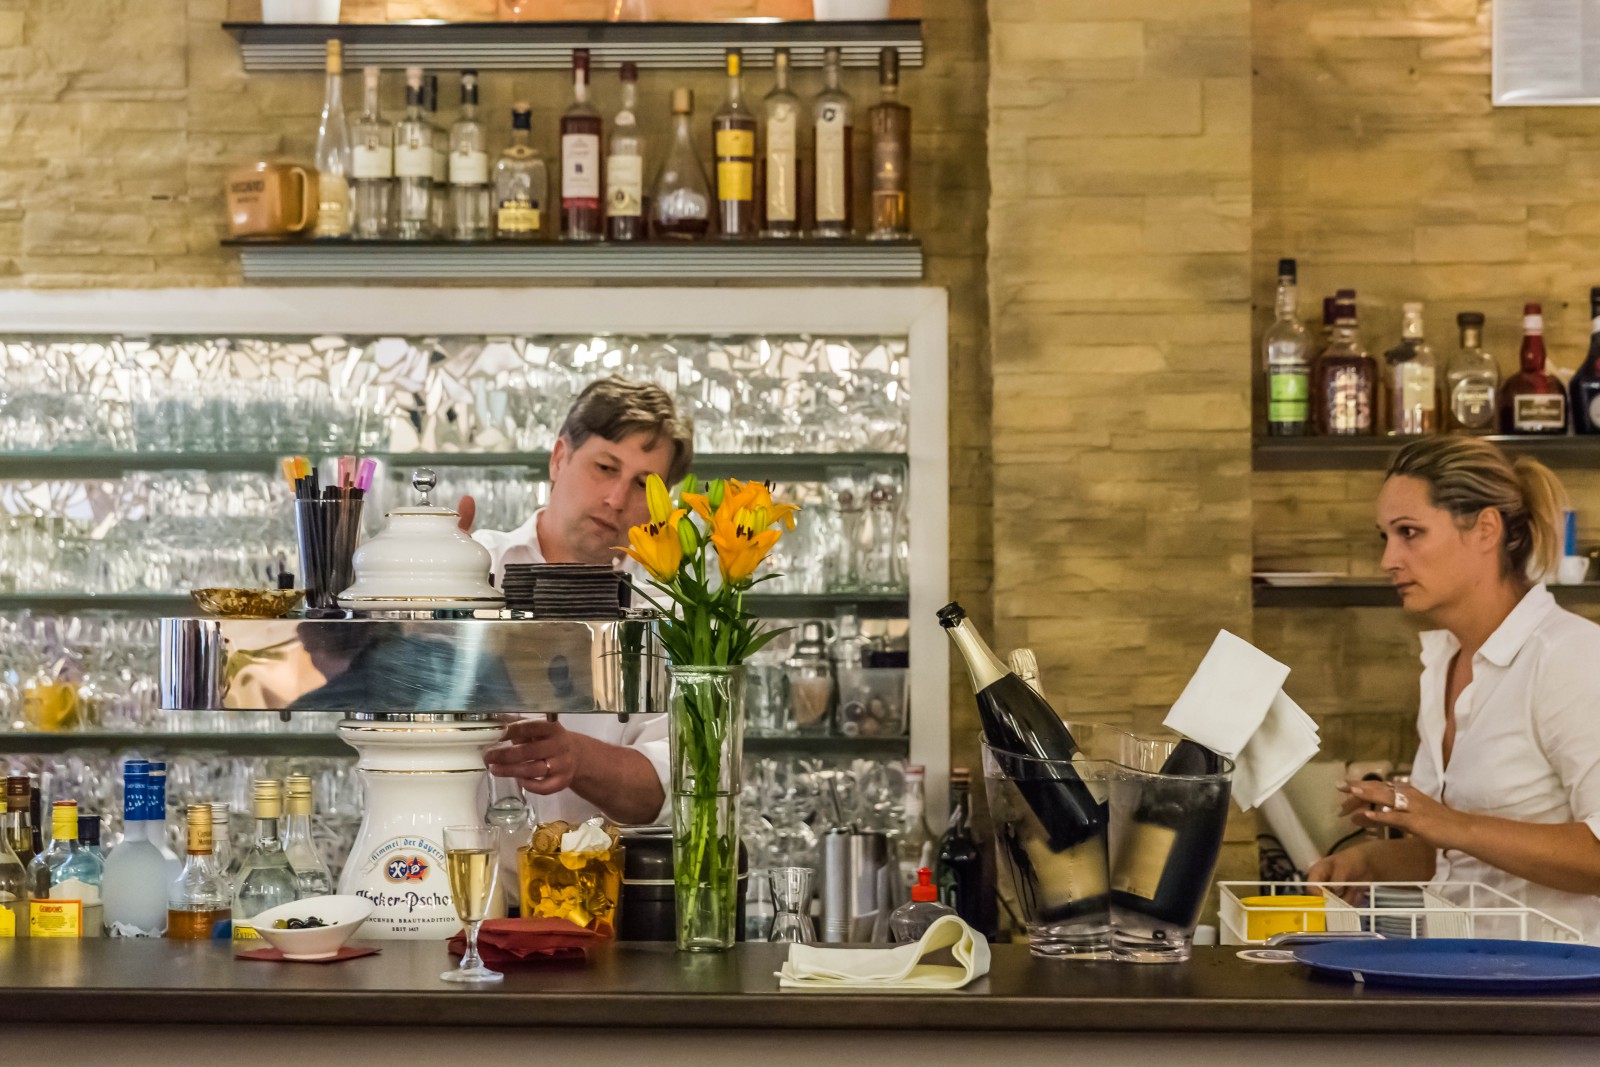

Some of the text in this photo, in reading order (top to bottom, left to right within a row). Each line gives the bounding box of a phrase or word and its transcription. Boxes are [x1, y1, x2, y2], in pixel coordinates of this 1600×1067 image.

[371, 838, 445, 861] Himmel der Bayern
[355, 889, 454, 913] cker-Pscho
